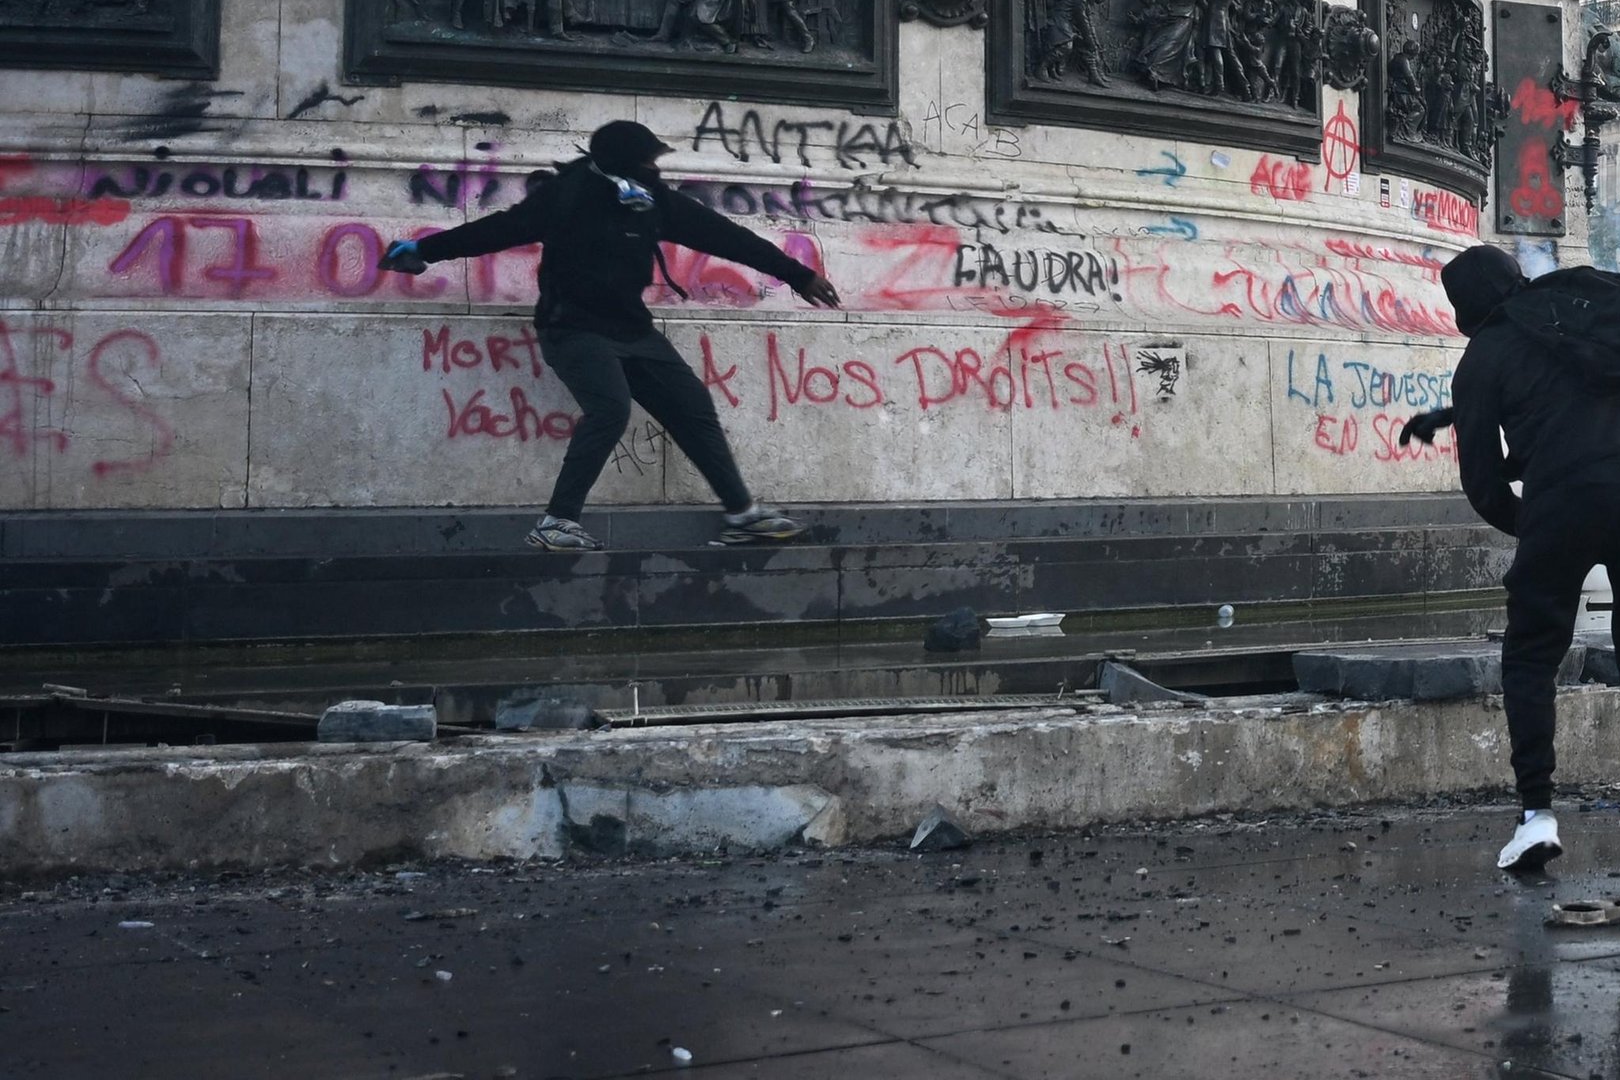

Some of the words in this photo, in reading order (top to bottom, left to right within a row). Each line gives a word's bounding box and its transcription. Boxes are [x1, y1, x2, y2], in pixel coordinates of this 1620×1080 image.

[110, 216, 280, 295] 17
[1287, 349, 1334, 407] LA
[1314, 413, 1359, 456] EN
